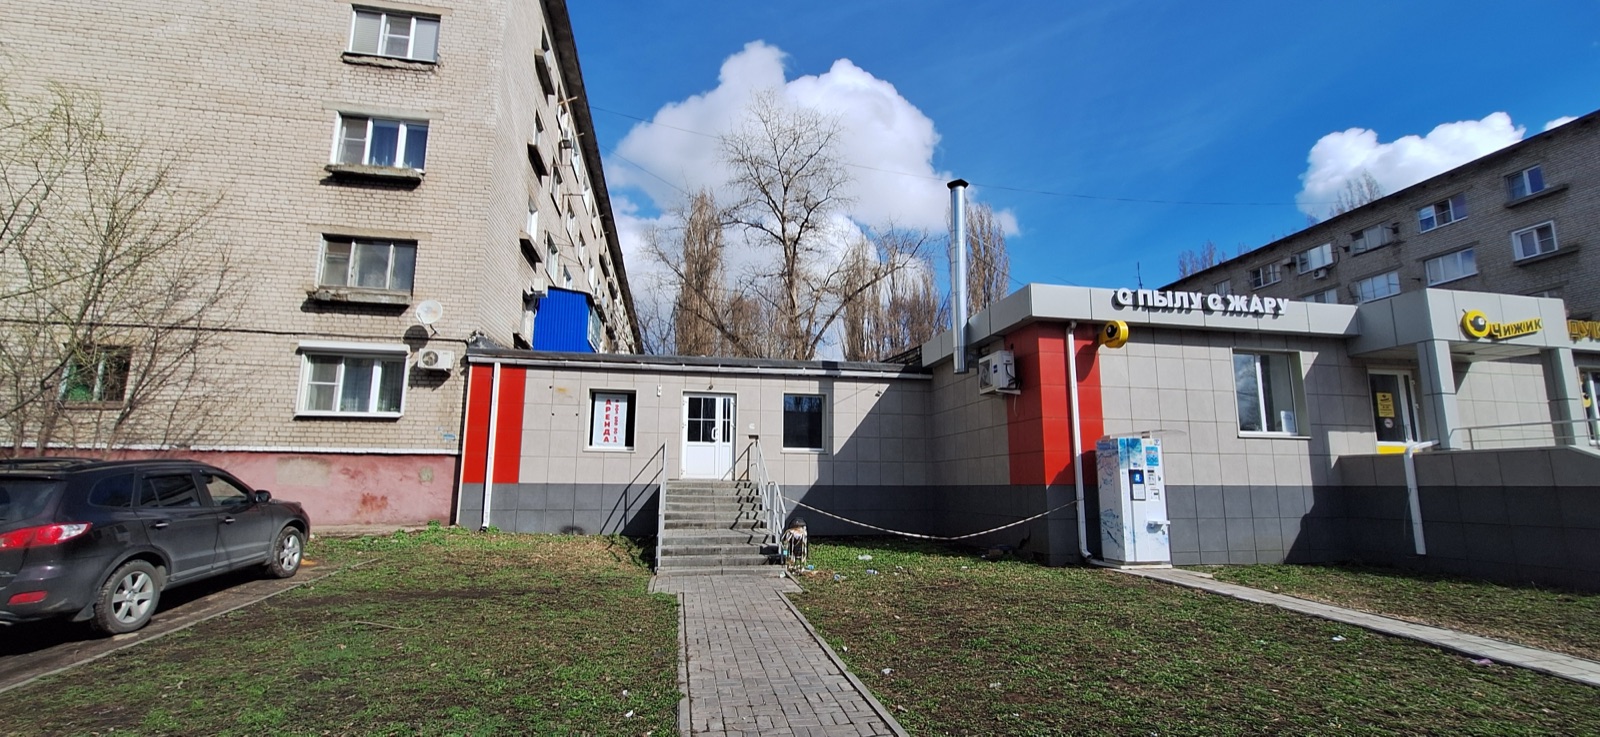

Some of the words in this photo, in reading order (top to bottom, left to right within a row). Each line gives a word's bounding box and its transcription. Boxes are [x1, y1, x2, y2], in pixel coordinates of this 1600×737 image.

[1138, 289, 1203, 309] ПЫЛУ
[1226, 294, 1290, 315] ЖАРУ
[603, 399, 612, 443] АРЕНДА
